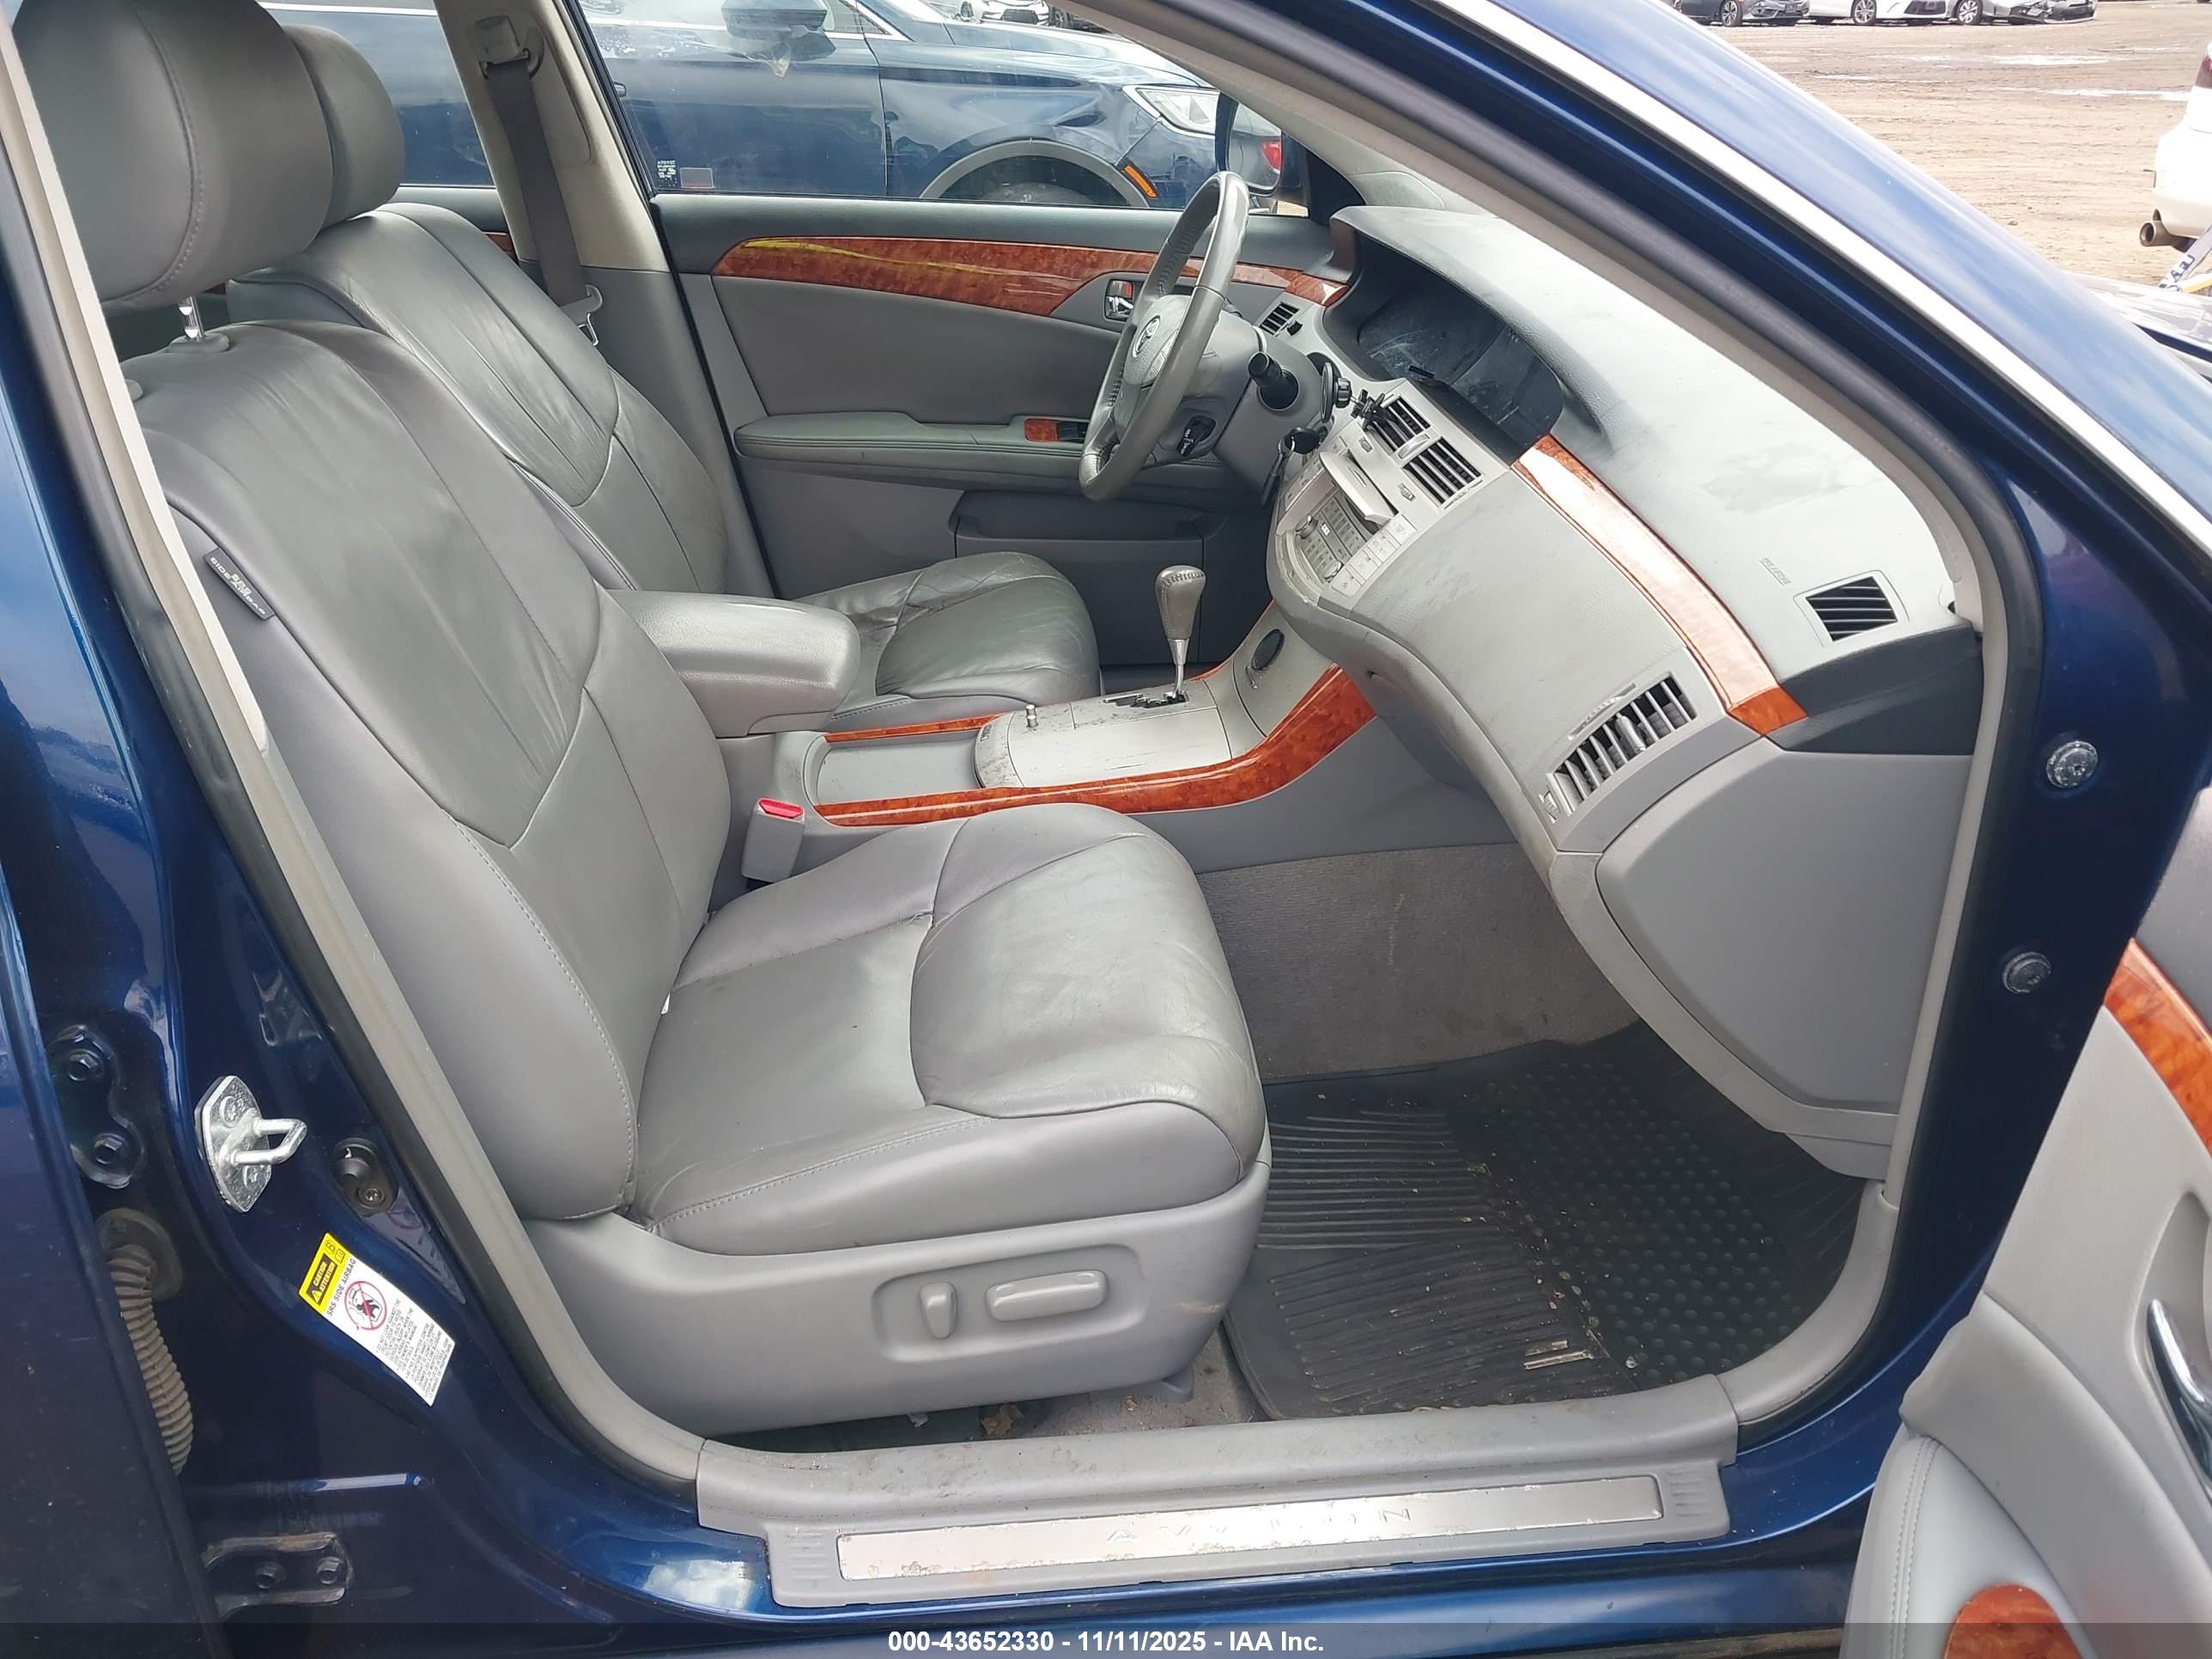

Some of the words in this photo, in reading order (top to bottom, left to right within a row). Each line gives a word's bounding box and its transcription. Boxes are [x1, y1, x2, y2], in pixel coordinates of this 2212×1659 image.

[326, 1300, 337, 1317] SRS
[333, 1282, 344, 1302] SIDE
[342, 1257, 356, 1285] AIRBAG
